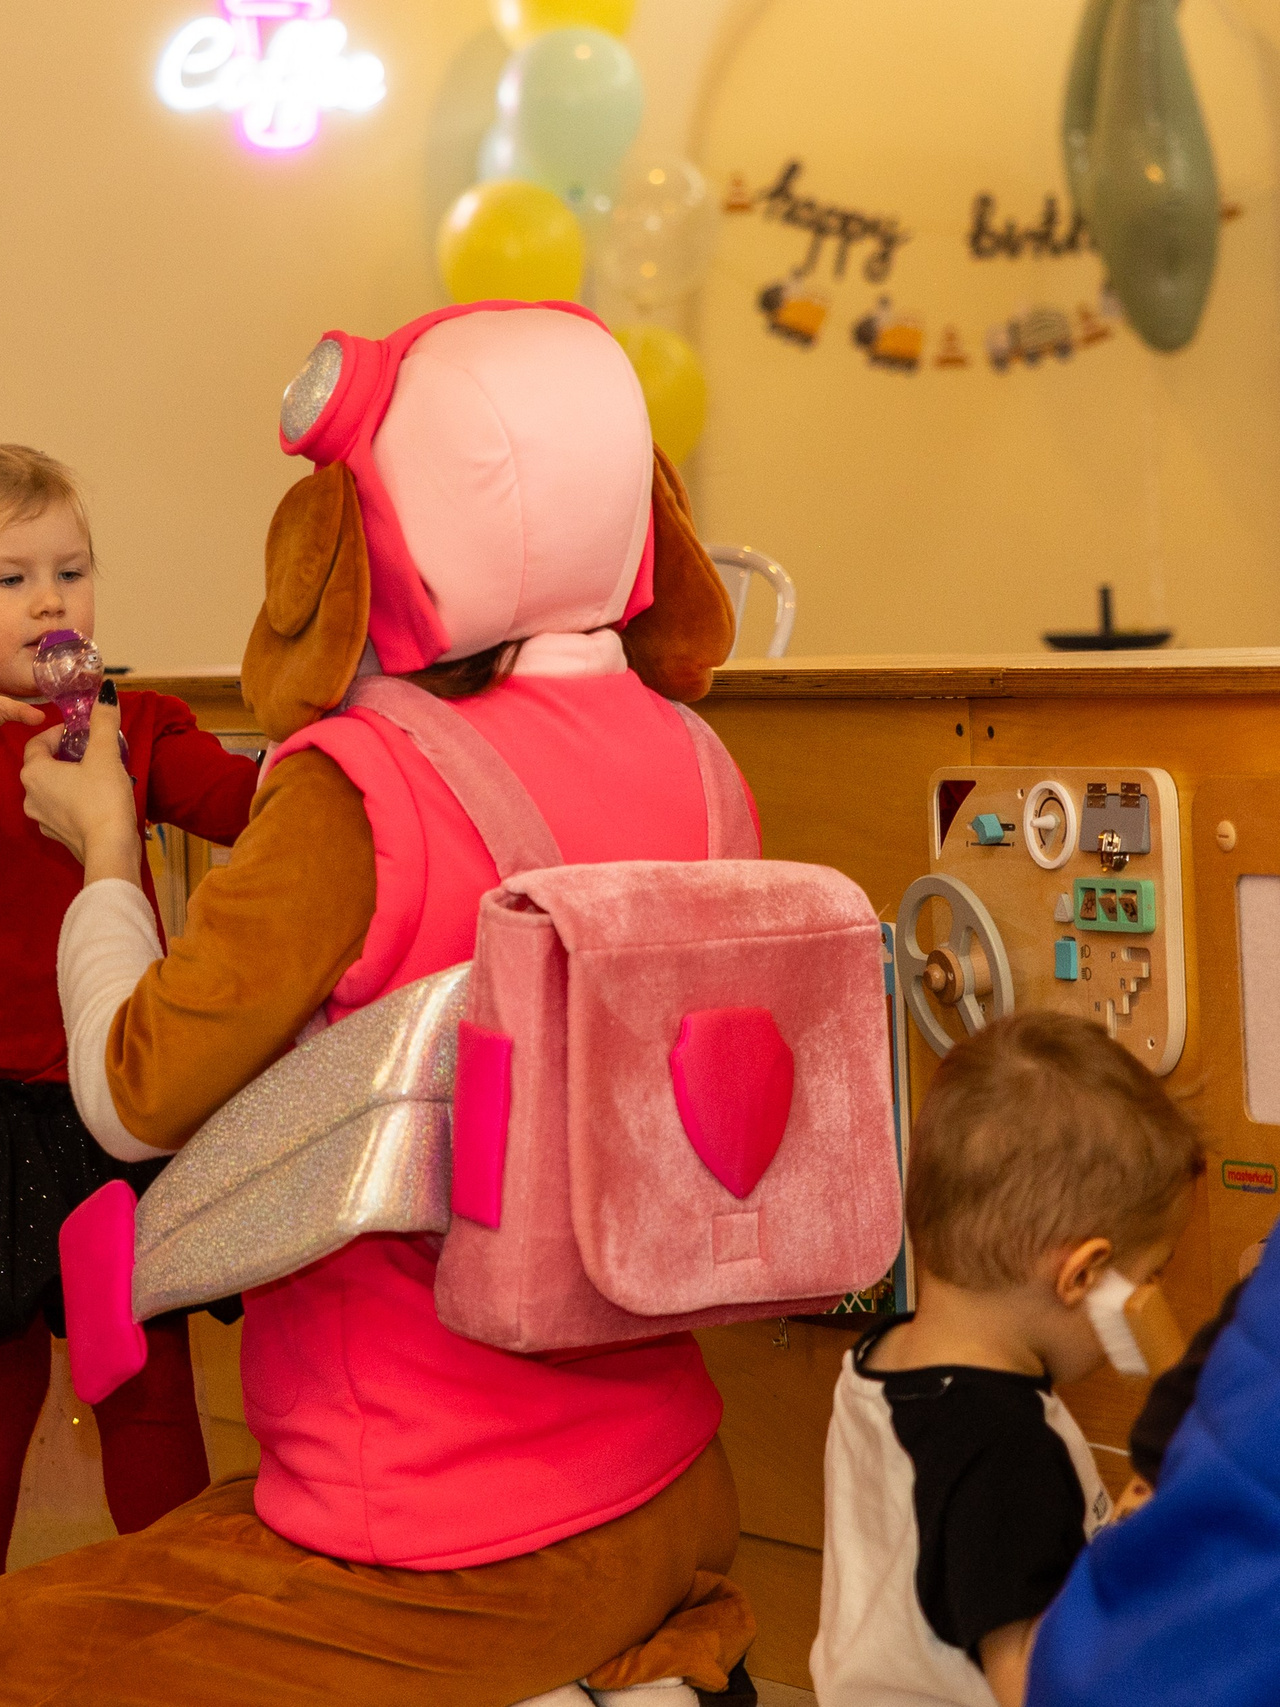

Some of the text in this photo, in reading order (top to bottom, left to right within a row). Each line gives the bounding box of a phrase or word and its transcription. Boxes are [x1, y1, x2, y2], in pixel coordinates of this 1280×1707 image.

[760, 158, 908, 285] happy
[1110, 951, 1116, 962] P
[1120, 977, 1126, 991] R
[1094, 1001, 1100, 1012] N
[1227, 1170, 1273, 1185] masterkidz
